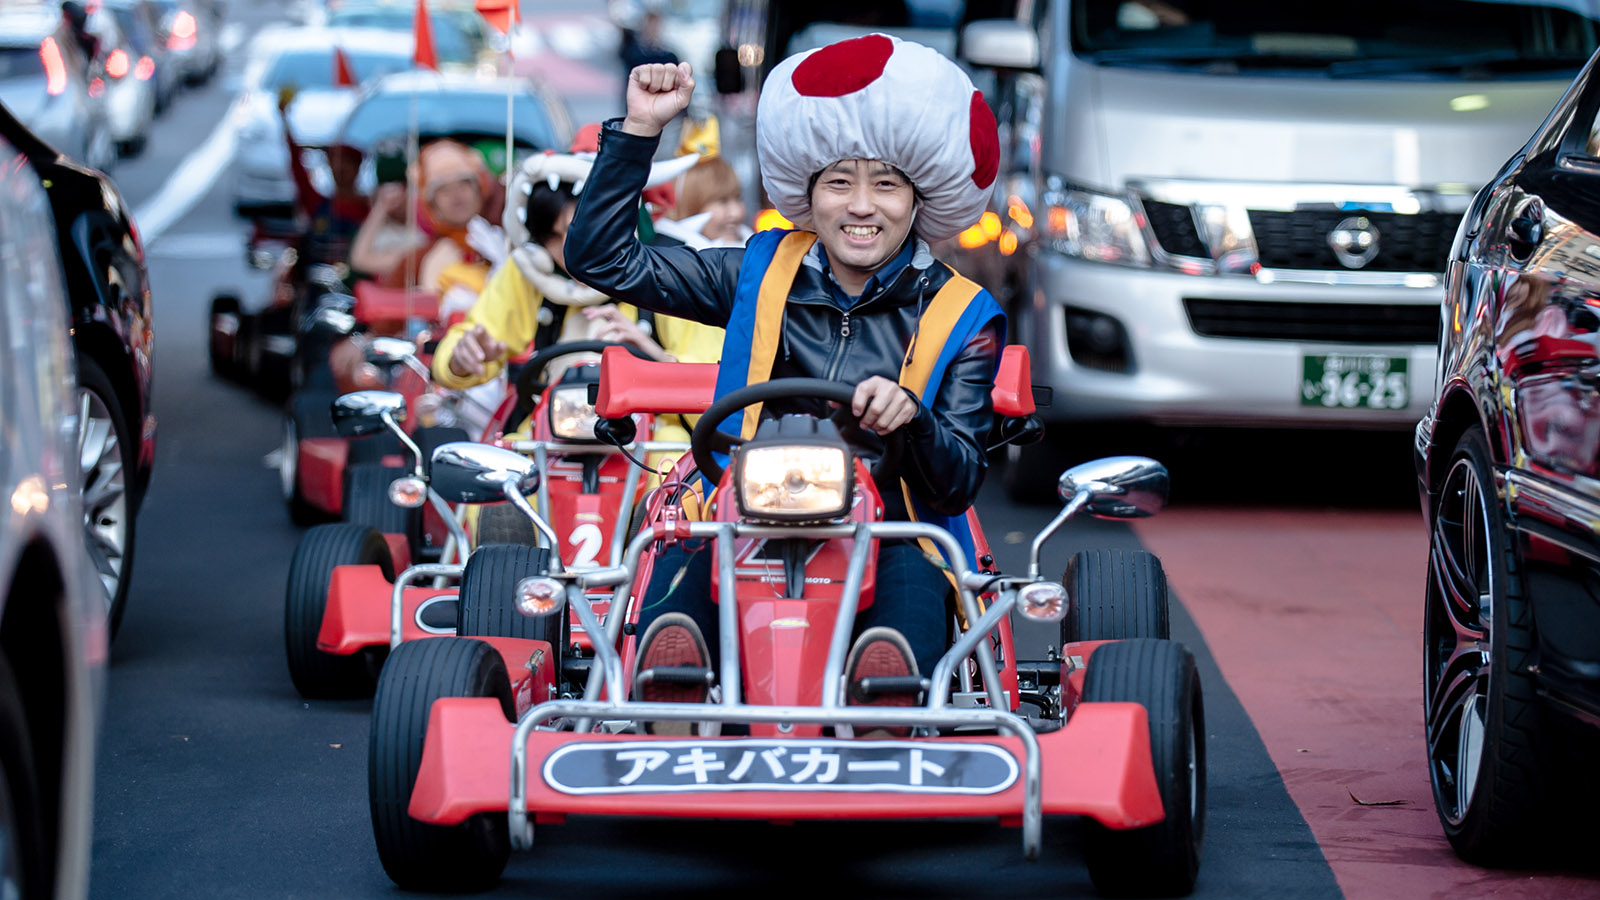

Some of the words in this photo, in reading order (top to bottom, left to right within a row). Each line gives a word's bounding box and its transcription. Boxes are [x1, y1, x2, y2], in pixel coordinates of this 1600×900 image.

[568, 523, 603, 567] 2
[616, 746, 945, 785] アキバカート
